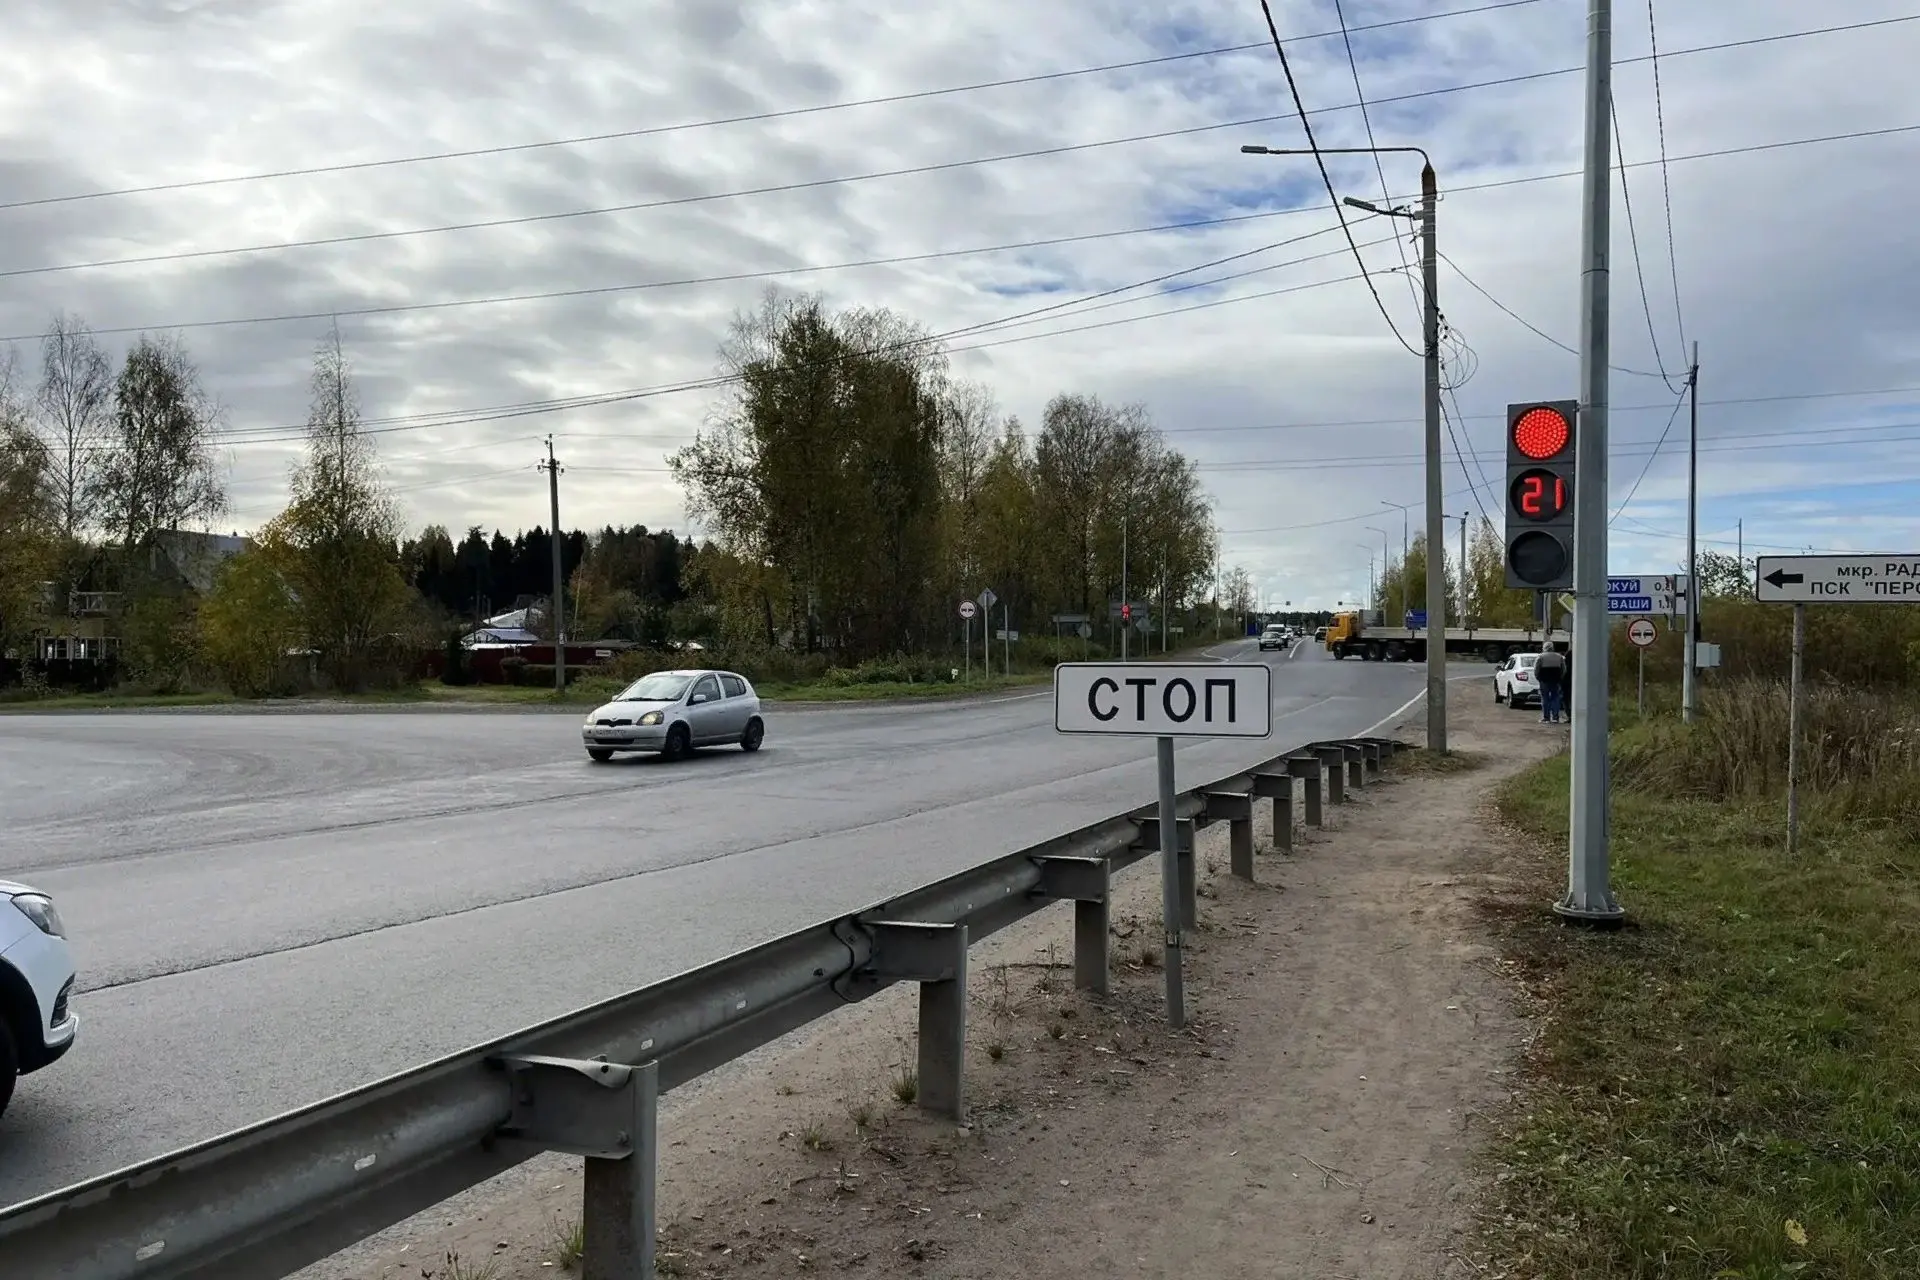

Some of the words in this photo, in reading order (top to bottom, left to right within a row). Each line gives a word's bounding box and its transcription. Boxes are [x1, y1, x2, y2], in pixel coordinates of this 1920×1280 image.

[1522, 476, 1563, 513] 21
[1837, 566, 1878, 579] мкр.
[1810, 581, 1850, 594] ПСК
[1087, 677, 1236, 723] СТОП
